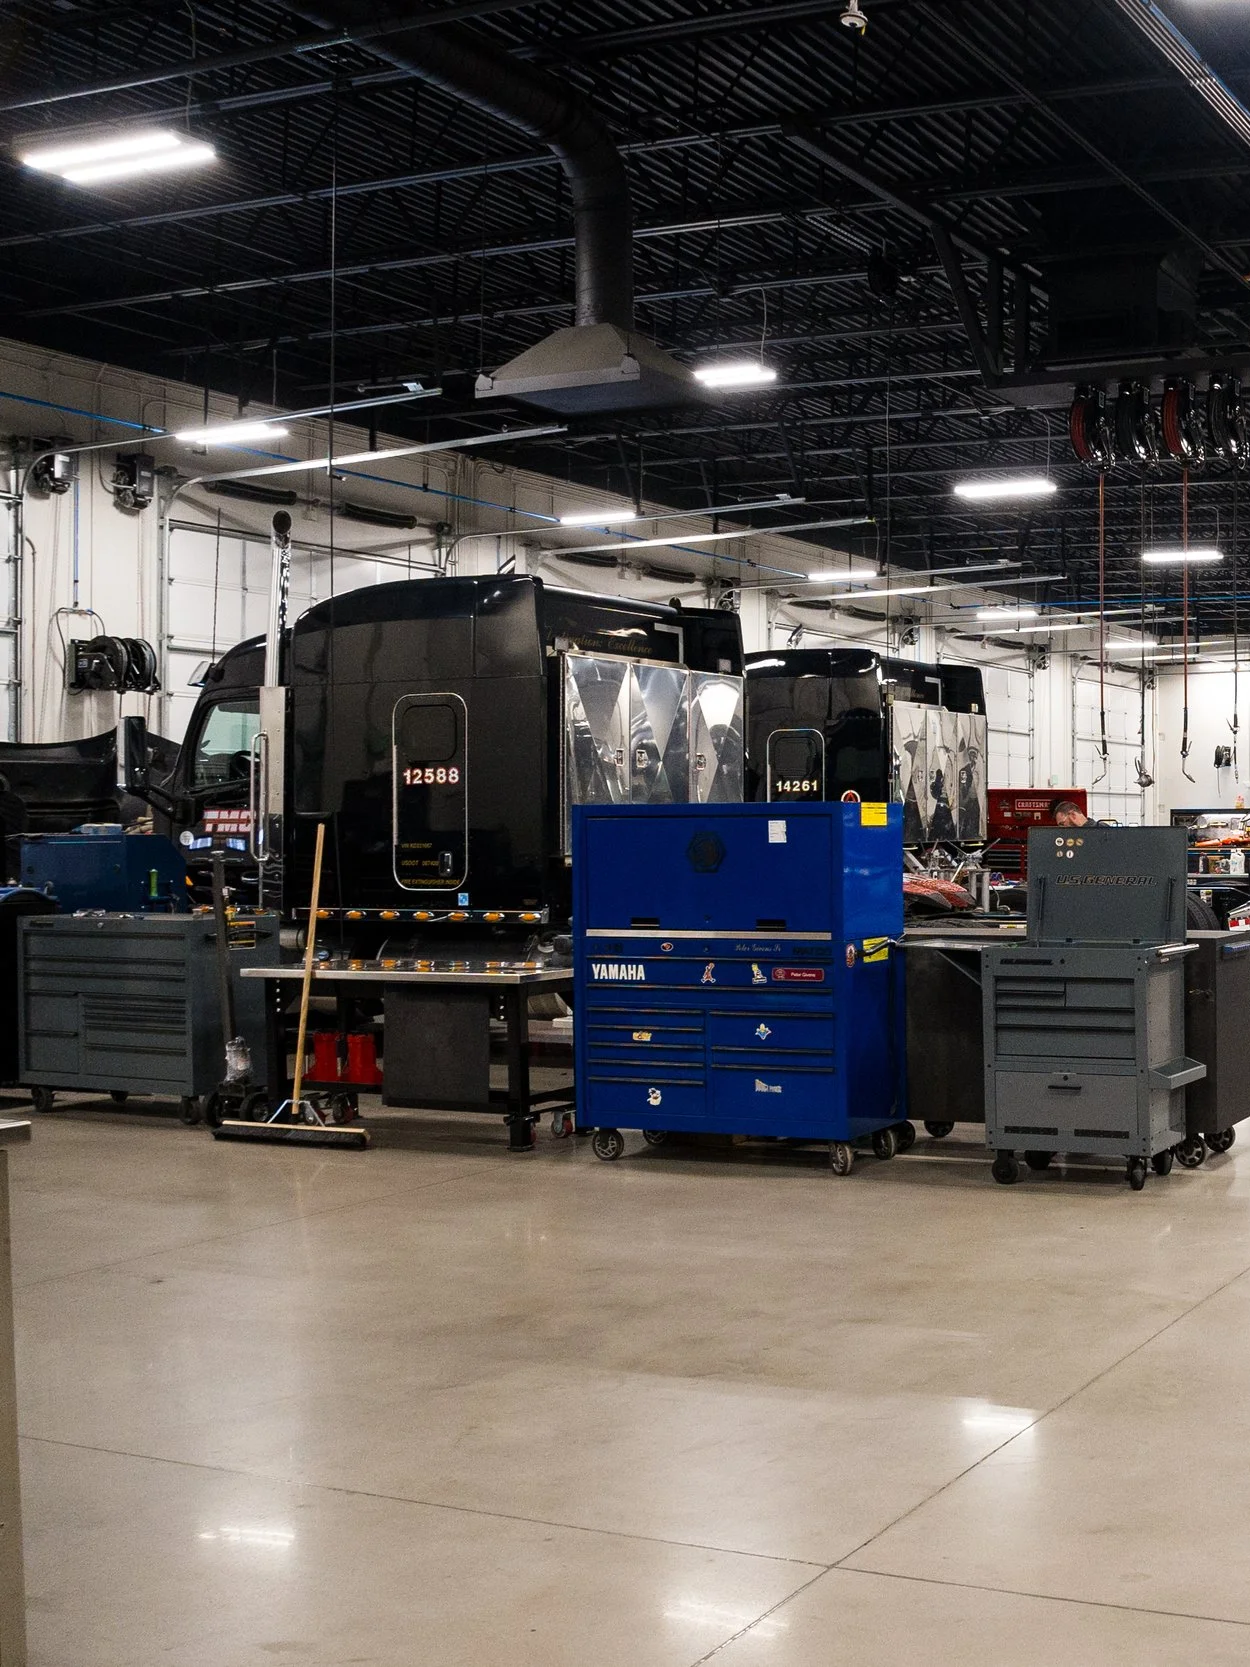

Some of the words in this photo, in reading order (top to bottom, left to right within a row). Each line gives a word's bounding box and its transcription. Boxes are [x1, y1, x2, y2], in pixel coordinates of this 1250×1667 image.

[403, 767, 460, 785] 12588
[776, 780, 818, 792] 14261
[1081, 875, 1158, 886] GENERAL
[591, 963, 645, 981] YAMAHA
